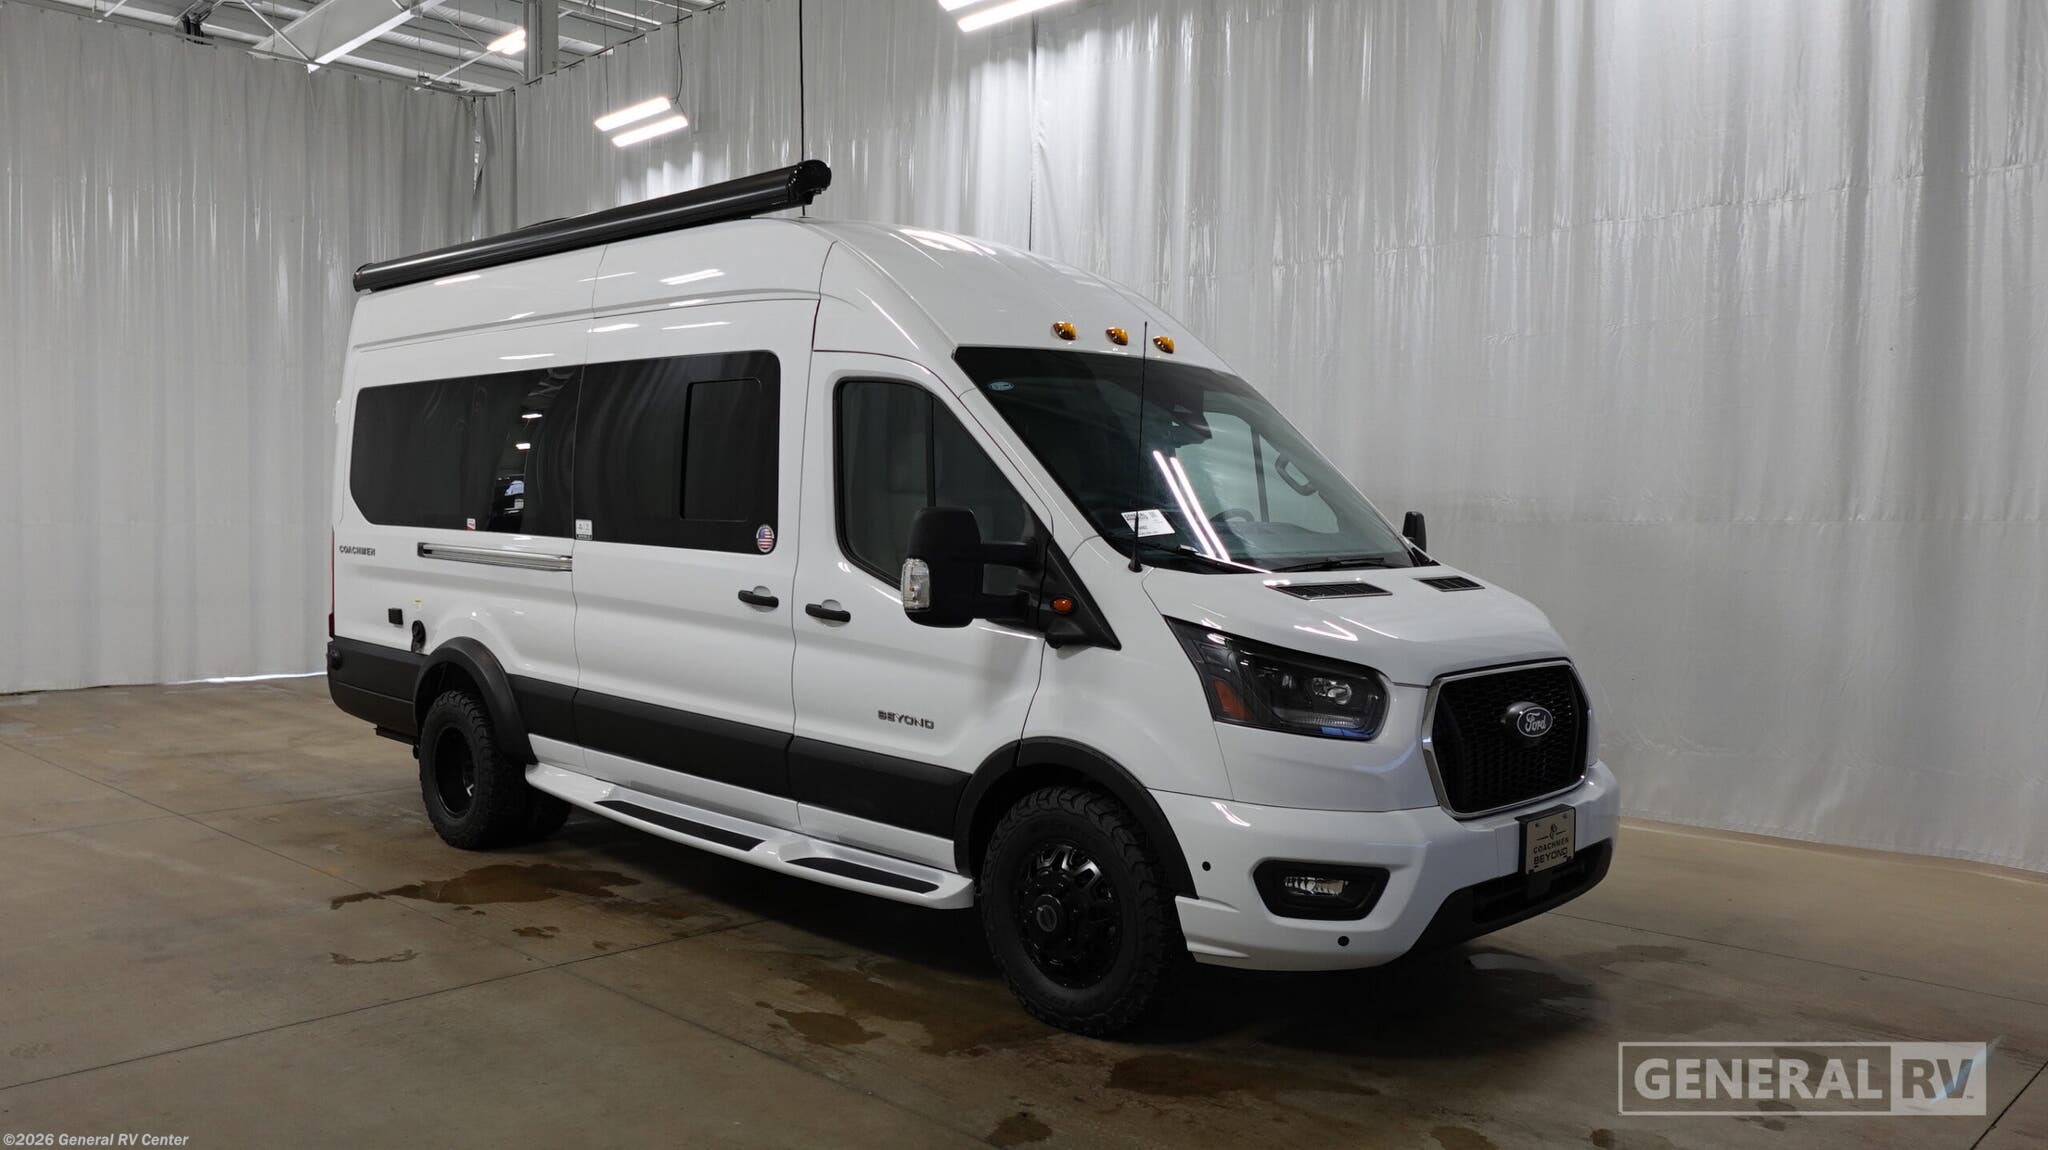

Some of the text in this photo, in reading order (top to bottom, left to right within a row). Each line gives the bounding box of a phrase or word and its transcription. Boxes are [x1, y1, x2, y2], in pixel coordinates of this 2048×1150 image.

[877, 710, 935, 730] BEYOND
[1525, 712, 1546, 732] Ford
[1533, 837, 1568, 854] COACHMEN
[1533, 847, 1567, 865] BEYOND
